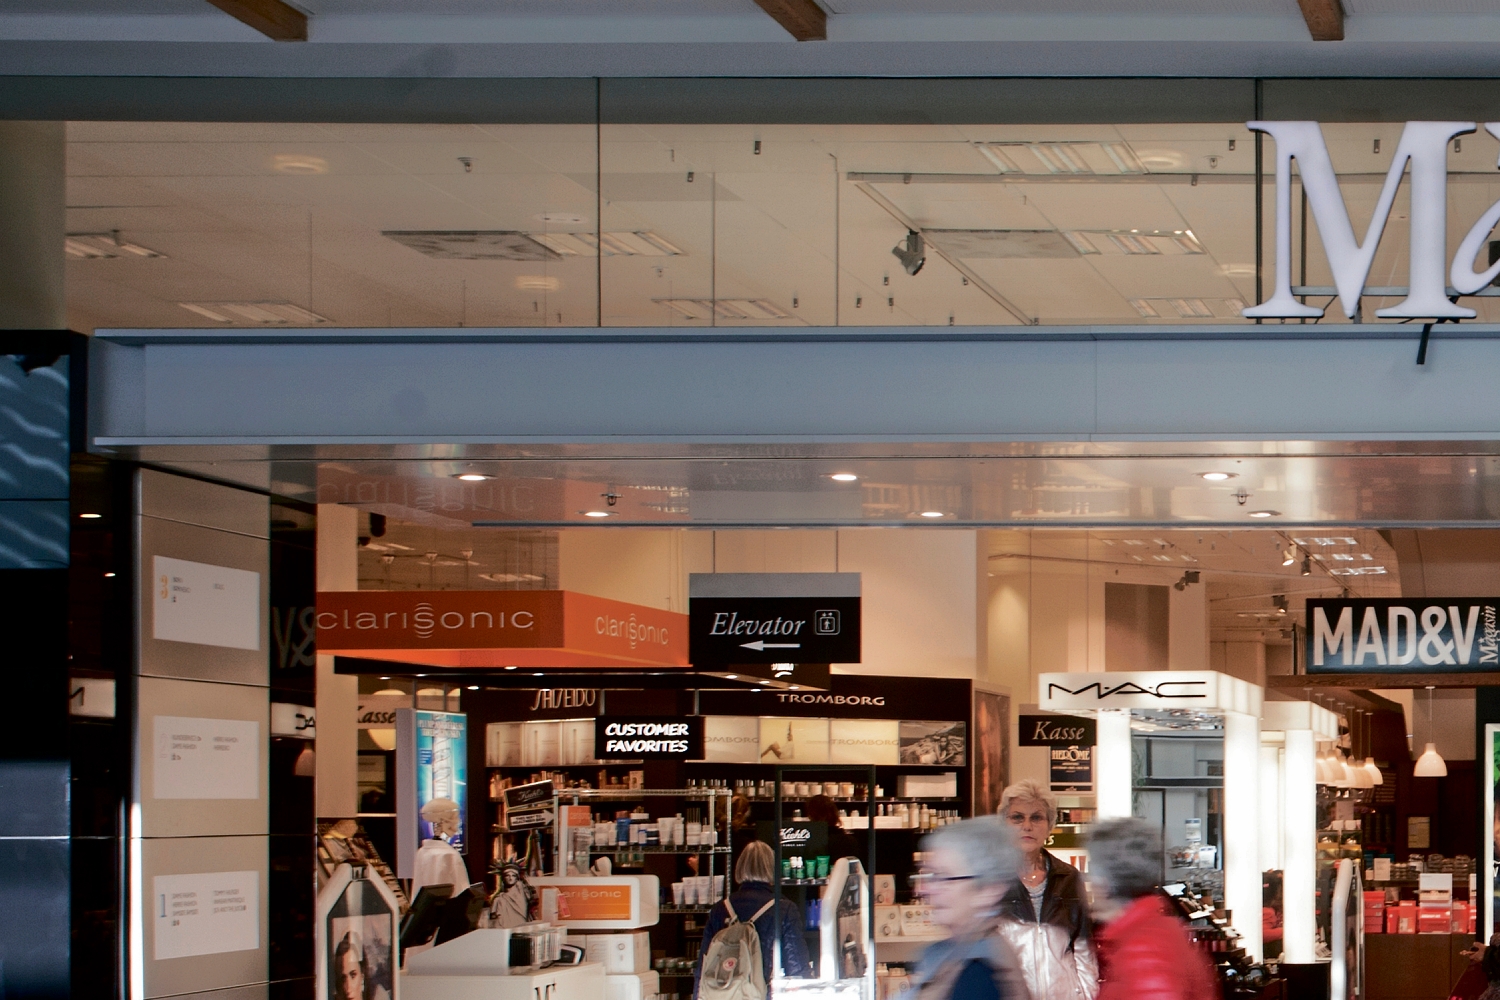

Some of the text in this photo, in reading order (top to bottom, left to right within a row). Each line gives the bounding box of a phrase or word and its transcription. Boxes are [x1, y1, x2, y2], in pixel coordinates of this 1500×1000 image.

[316, 603, 535, 638] clarisonic
[709, 611, 806, 636] Elevator
[595, 613, 669, 649] clarisonic
[529, 689, 596, 711] SHISEIDO
[777, 693, 885, 706] TROMBORG
[605, 722, 689, 736] CUSTOMER
[1032, 720, 1085, 741] Kasse
[606, 740, 689, 753] FAVORITES
[704, 735, 759, 744] OMBORG
[832, 738, 900, 746] TROMBORG
[564, 889, 622, 900] arisonic
